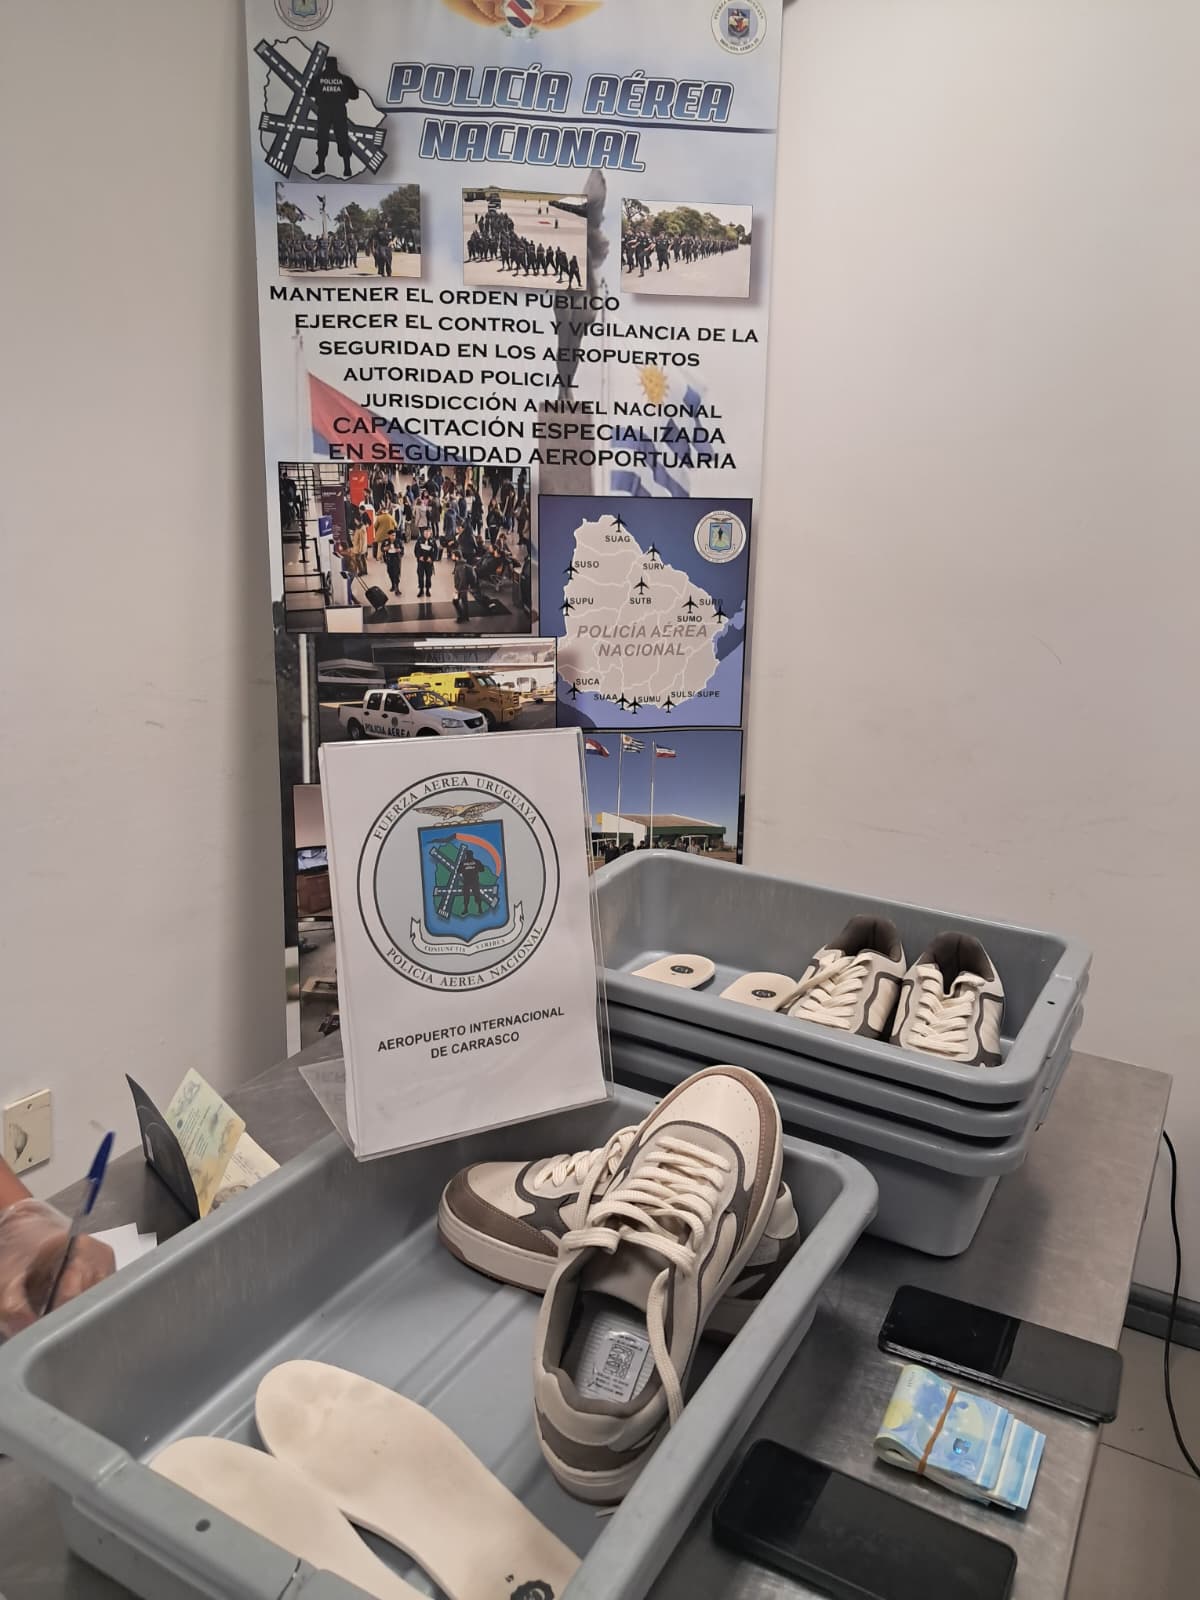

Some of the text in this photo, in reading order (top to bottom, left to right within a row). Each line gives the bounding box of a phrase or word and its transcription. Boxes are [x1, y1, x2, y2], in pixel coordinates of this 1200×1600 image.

[386, 61, 735, 123] POLICÍA AÉREA
[419, 119, 646, 172] NACIONAL
[269, 285, 620, 311] MANTENER EL ORDEN PÚBLICO
[295, 313, 759, 343] EJERCER EL CONTROL Y VIGILANCIA DE LA
[318, 340, 700, 367] SEGURIDAD EN LOS AEROPUERTOS
[343, 366, 579, 388] AUTORIDAD POLICIAL
[361, 391, 722, 419] JURISDICCIÓN A NIVEL NACIONAL
[332, 415, 726, 444] CAPACITACIÓN ESPECIALIZADA
[328, 443, 737, 469] EN SEGURIDAD AEROPORTUARIA
[605, 535, 631, 543] SUAG
[574, 560, 600, 569] SUSO
[643, 562, 665, 570] SURV
[570, 597, 594, 605] SUPU
[629, 597, 652, 605] SUTB
[577, 622, 708, 638] POLICÍA AÉREA
[677, 615, 703, 623] SUMO
[598, 642, 686, 657] NACIONAL
[575, 678, 600, 686] SUCA
[697, 690, 720, 698] SUPE
[593, 693, 618, 701] SUAA
[373, 776, 537, 840] FUERZA AEREA URUGUAYA
[386, 926, 543, 987] POLICIA AEREA NACIONAL
[377, 1005, 565, 1052] AEROPUERTO INTERNACIONAL
[431, 1031, 520, 1059] DE CARRASCO
